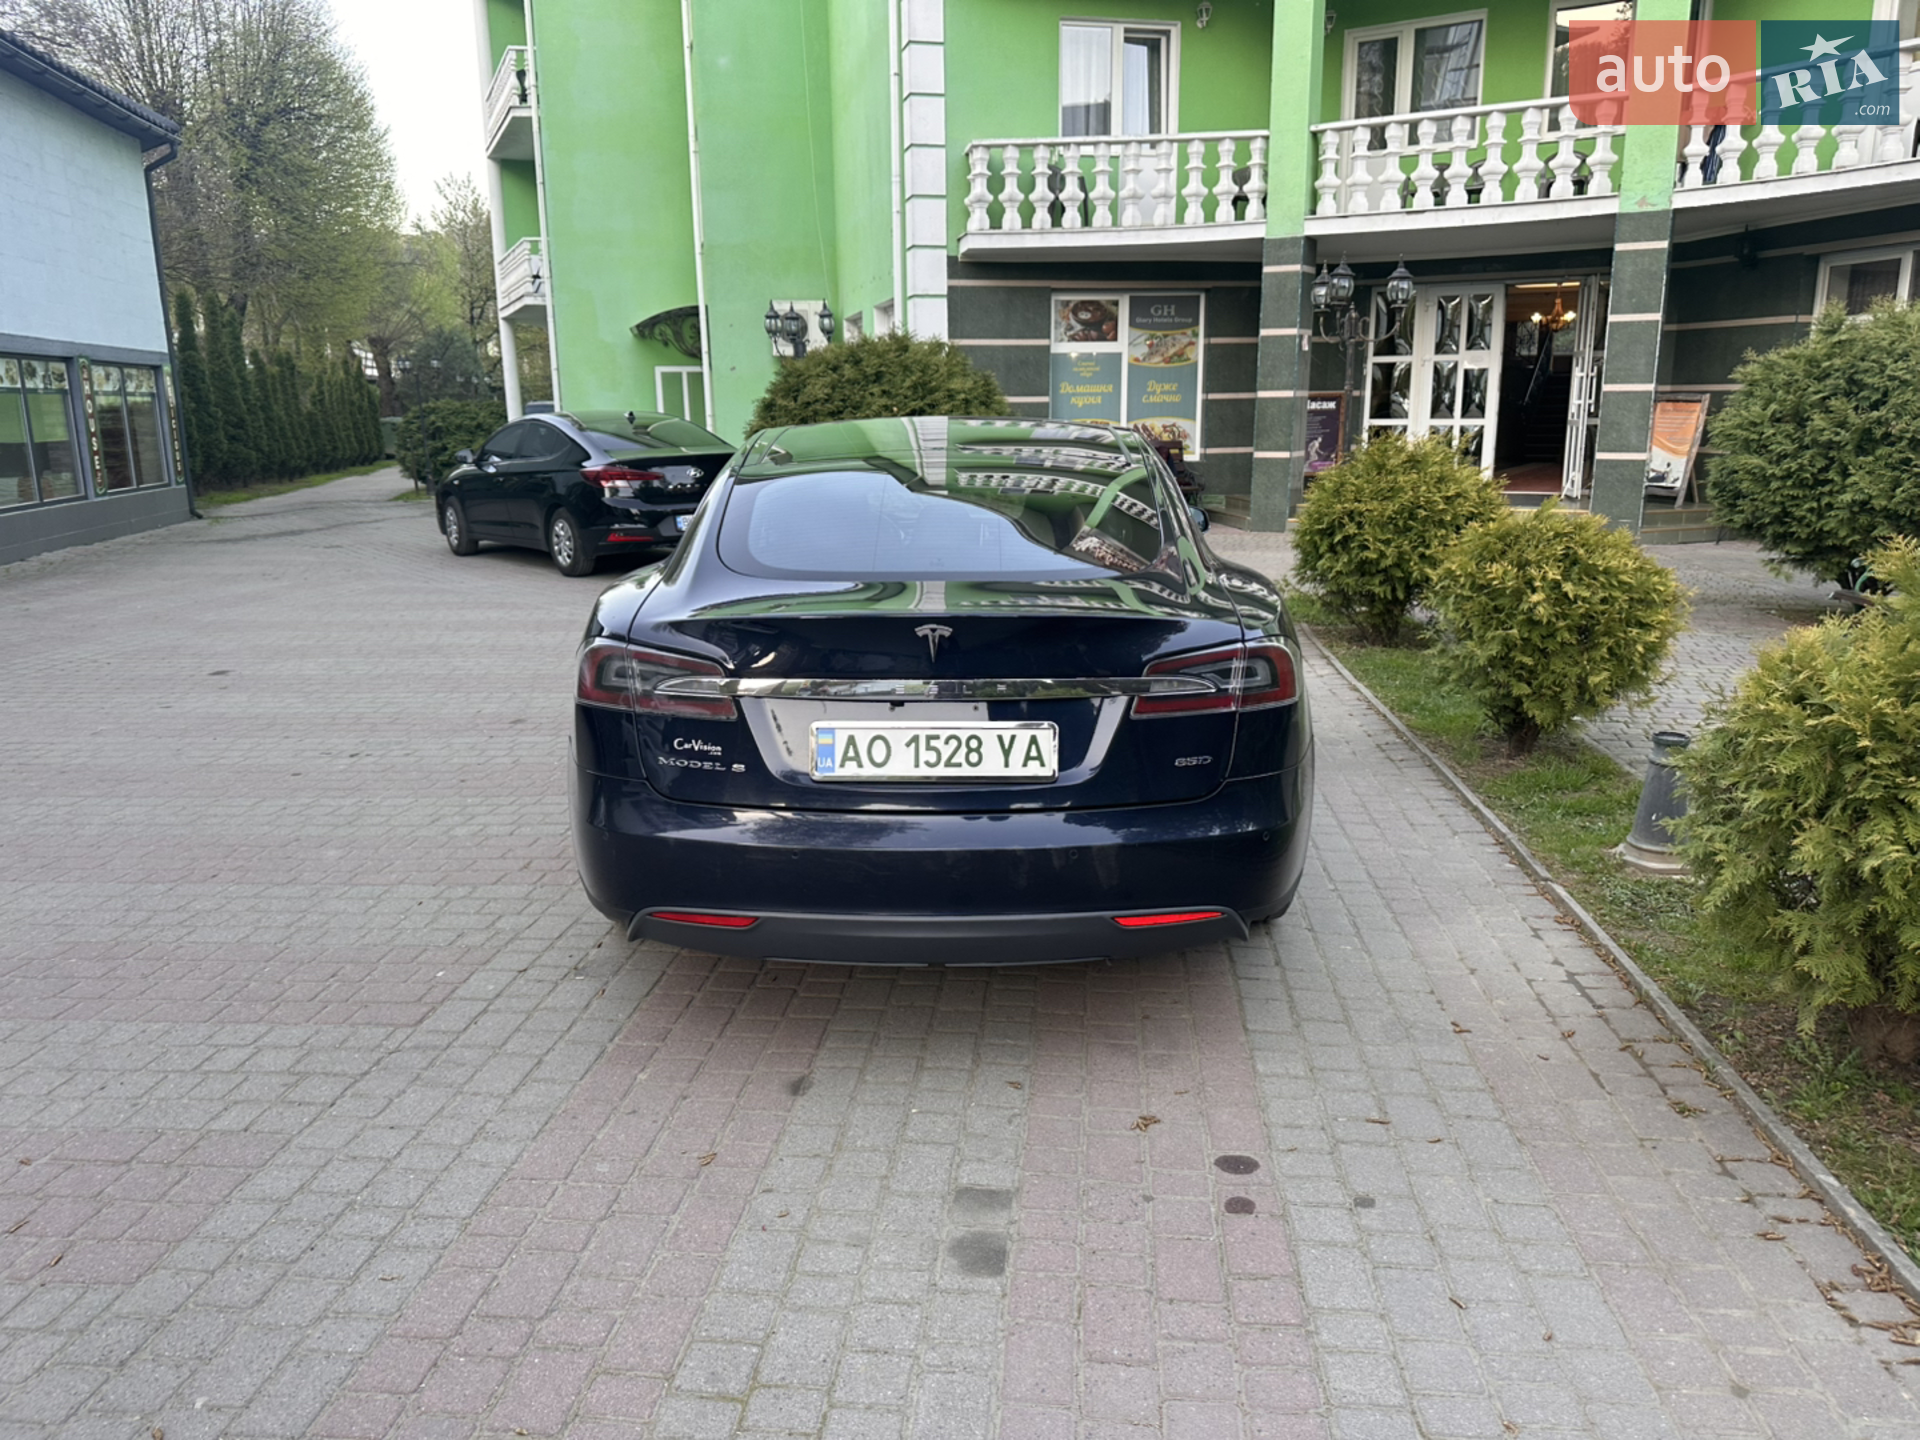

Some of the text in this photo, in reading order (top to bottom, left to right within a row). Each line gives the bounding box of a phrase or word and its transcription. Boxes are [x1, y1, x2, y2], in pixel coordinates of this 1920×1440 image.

[1150, 304, 1176, 316] GH
[1059, 381, 1113, 394] Домашня
[1147, 380, 1179, 394] Дуже
[1070, 394, 1102, 407] кухня
[1142, 393, 1182, 403] смачно
[673, 737, 722, 751] CarVision
[839, 734, 1046, 768] AO 1528 YA
[657, 756, 746, 773] MODEL S
[817, 757, 833, 768] UA
